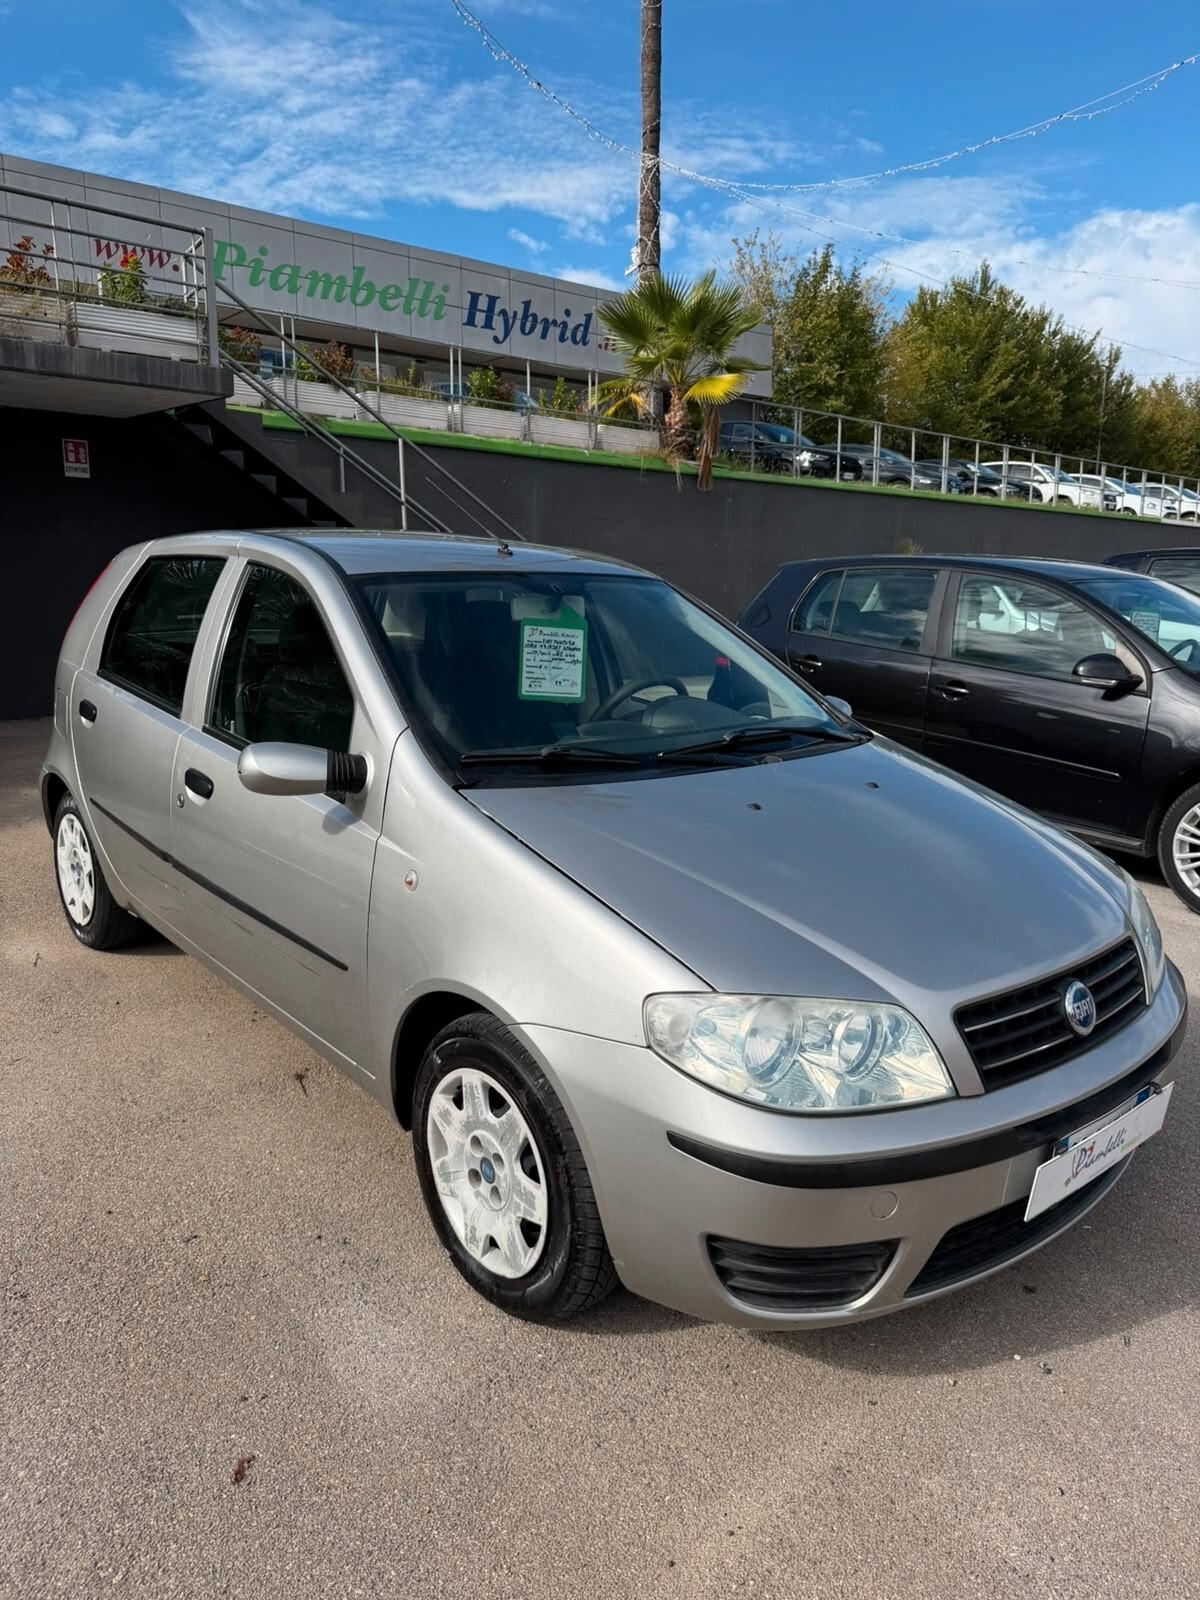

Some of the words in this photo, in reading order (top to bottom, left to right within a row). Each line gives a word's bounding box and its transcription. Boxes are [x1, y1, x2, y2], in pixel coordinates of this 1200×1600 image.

[213, 239, 450, 321] Piambelli
[462, 290, 594, 346] Hybrid
[1073, 998, 1093, 1021] FIAT
[1071, 1127, 1128, 1179] Piambelli
